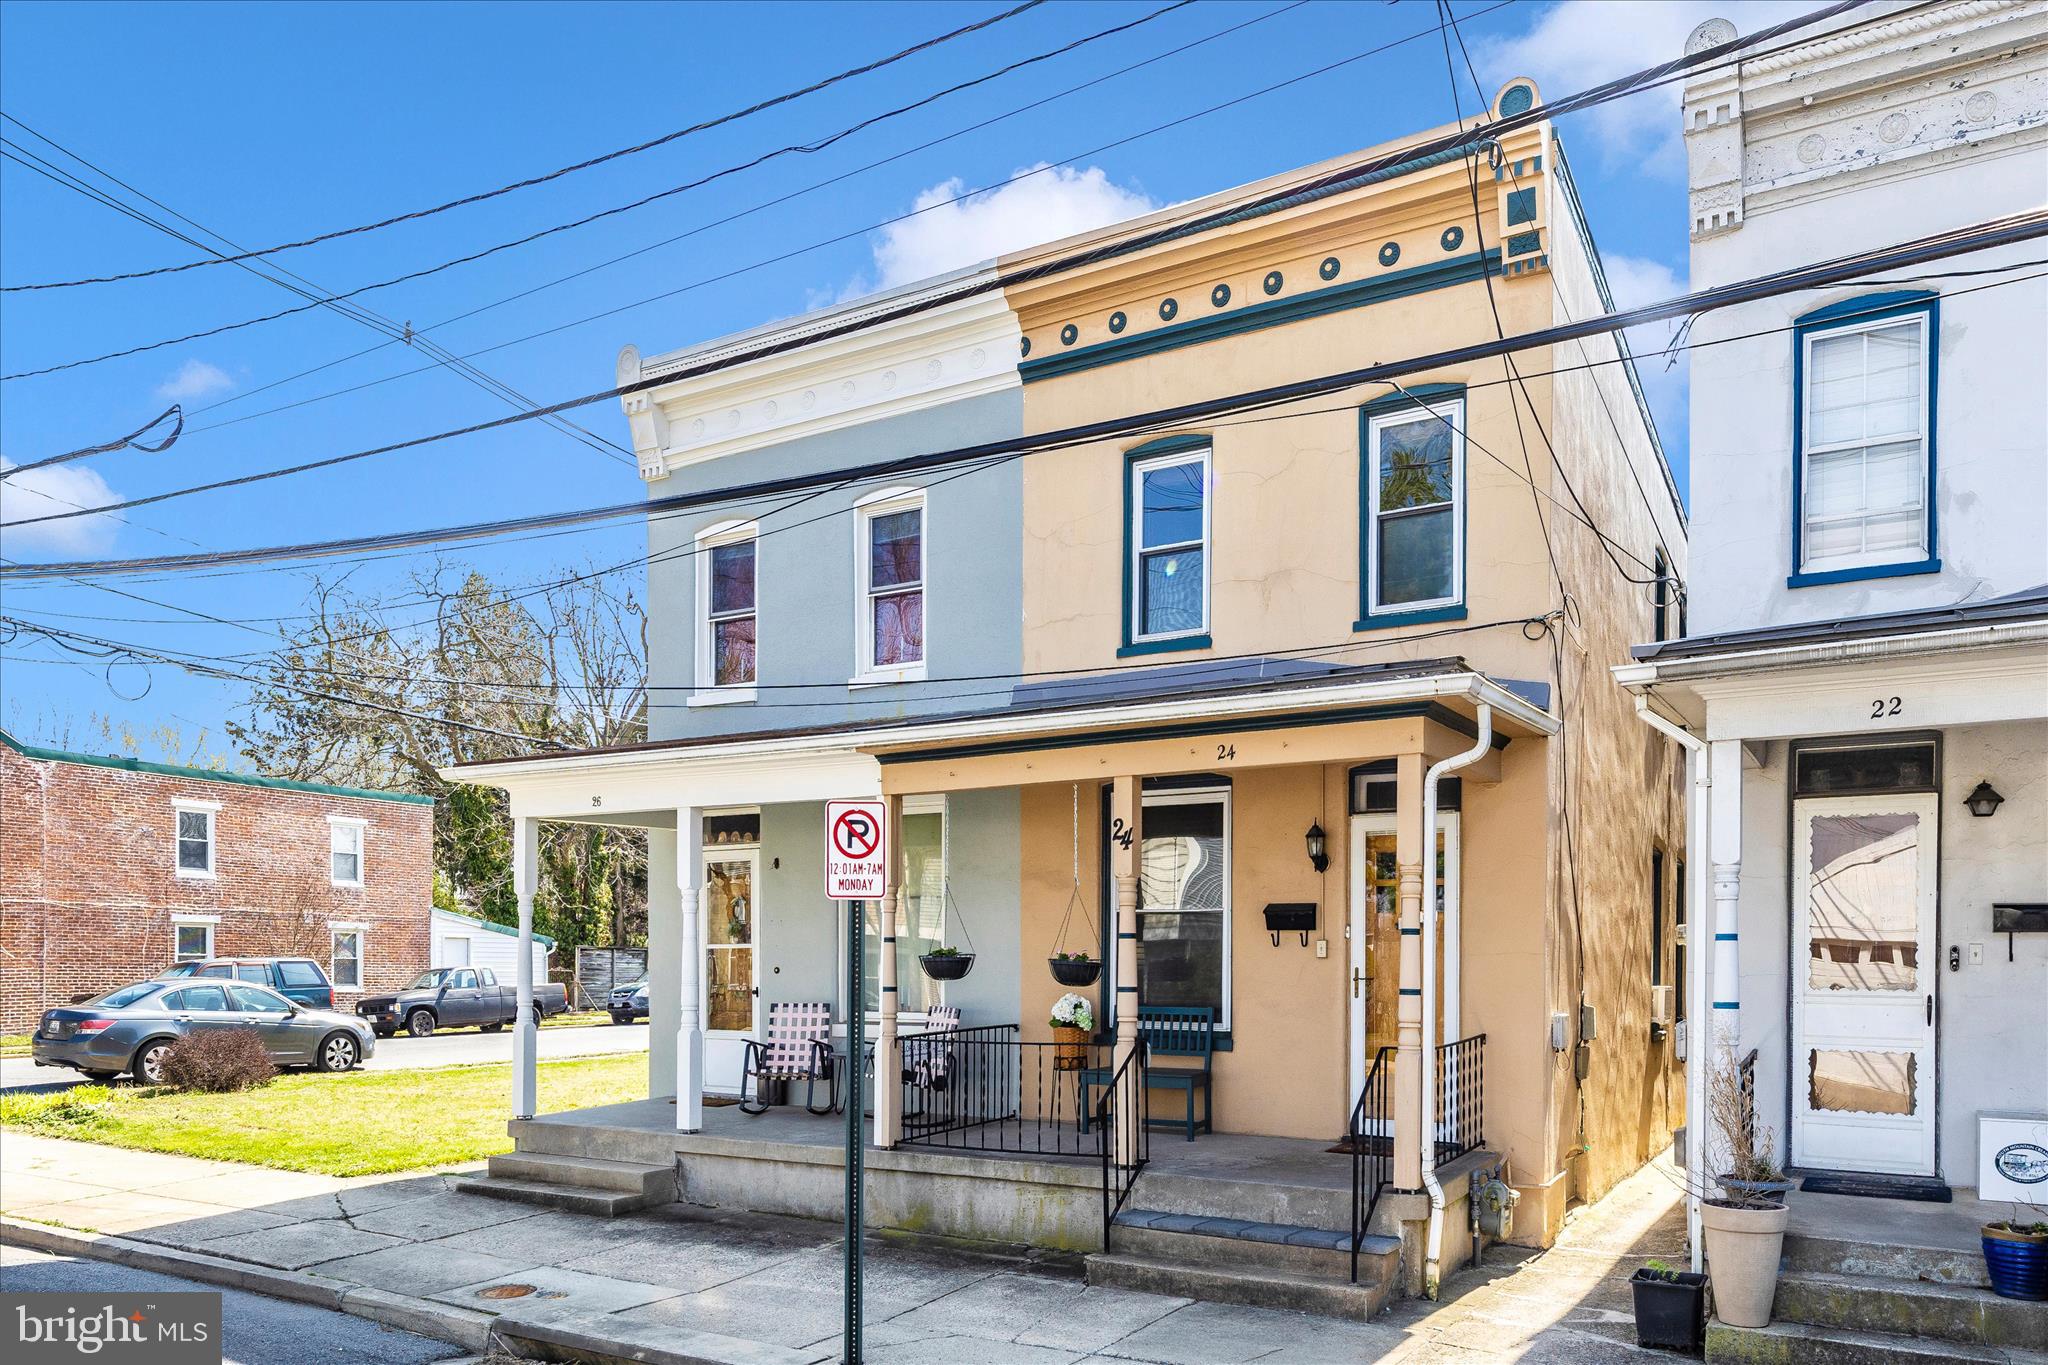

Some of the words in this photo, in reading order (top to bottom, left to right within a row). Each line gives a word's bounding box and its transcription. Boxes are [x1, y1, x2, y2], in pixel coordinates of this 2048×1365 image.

[1870, 696, 1902, 720] 22
[1217, 744, 1236, 760] 24
[592, 796, 602, 807] 26
[1112, 818, 1134, 850] 24
[838, 878, 874, 891] MONDAY
[1996, 1147, 2010, 1159] SOUTH
